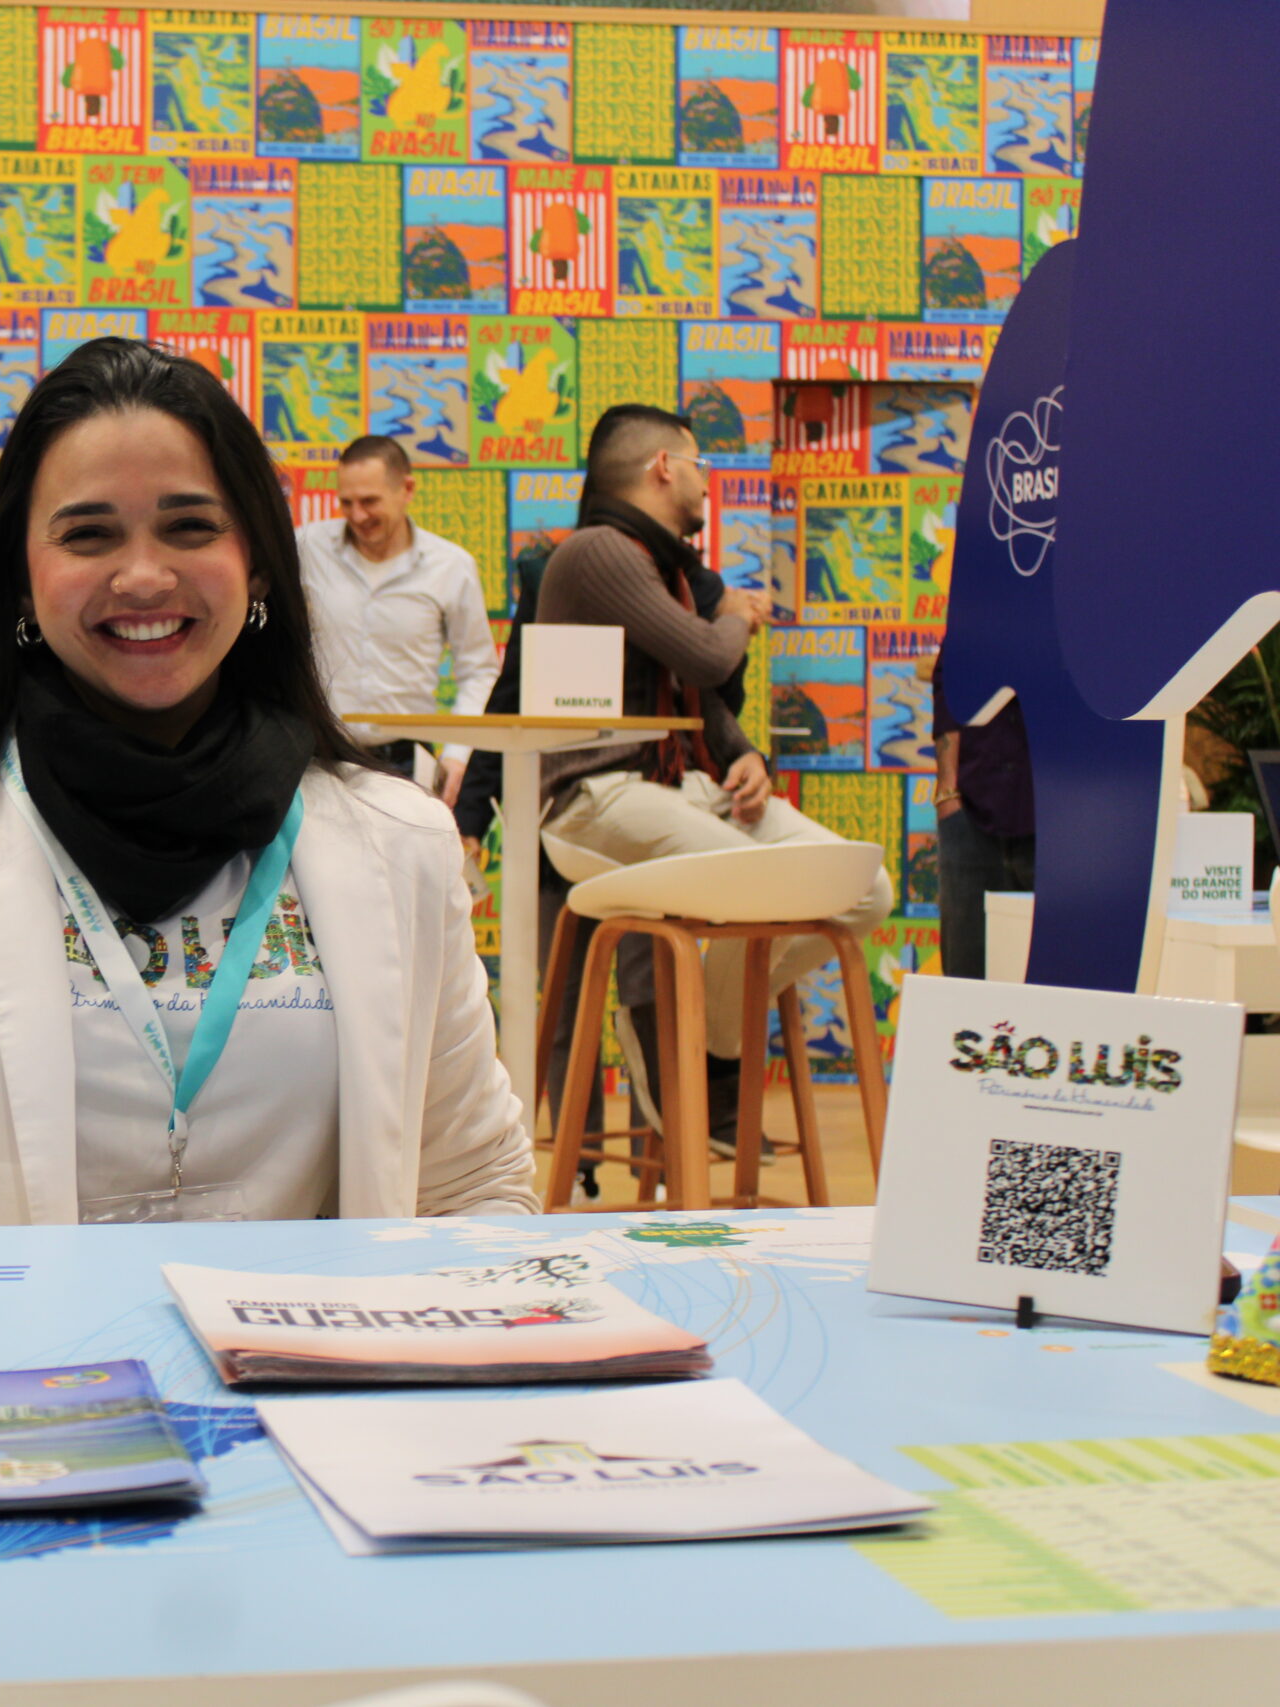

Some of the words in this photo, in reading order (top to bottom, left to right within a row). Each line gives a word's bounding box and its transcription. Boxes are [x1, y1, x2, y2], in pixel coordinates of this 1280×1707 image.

[156, 313, 220, 335] MADE
[227, 314, 250, 335] IN
[791, 324, 852, 346] MADE
[857, 324, 877, 346] IN
[515, 474, 584, 502] BRAS
[1204, 865, 1242, 877] VISITE
[1170, 877, 1190, 889] RIO
[1193, 877, 1242, 889] GRANDE
[1182, 889, 1199, 900] DO
[1202, 889, 1242, 900] NORTE
[167, 992, 196, 1012] da
